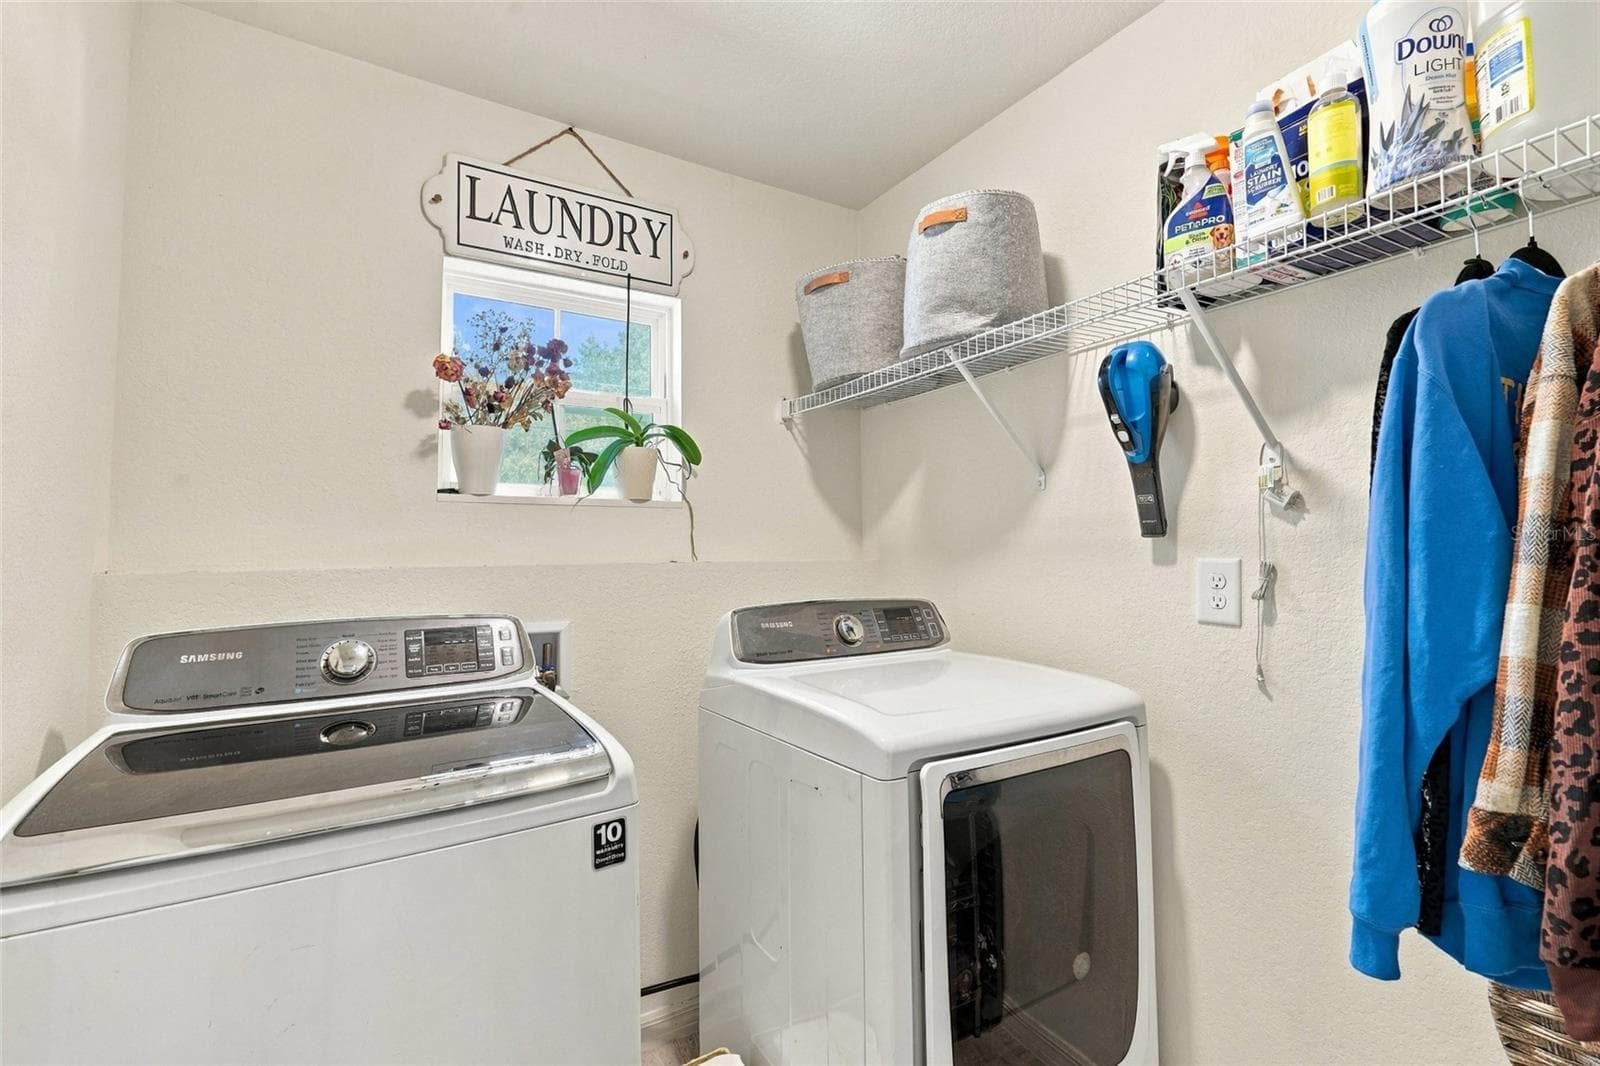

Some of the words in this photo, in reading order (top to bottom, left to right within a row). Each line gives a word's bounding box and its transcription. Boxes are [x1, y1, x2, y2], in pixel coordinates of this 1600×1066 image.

[1414, 57, 1462, 76] LIGHT
[1247, 167, 1282, 188] STAIN
[465, 175, 667, 260] LAUNDRY
[1174, 222, 1196, 234] PET
[1202, 214, 1226, 227] PRO
[180, 651, 244, 664] SAMSUNG
[596, 821, 623, 846] 10
